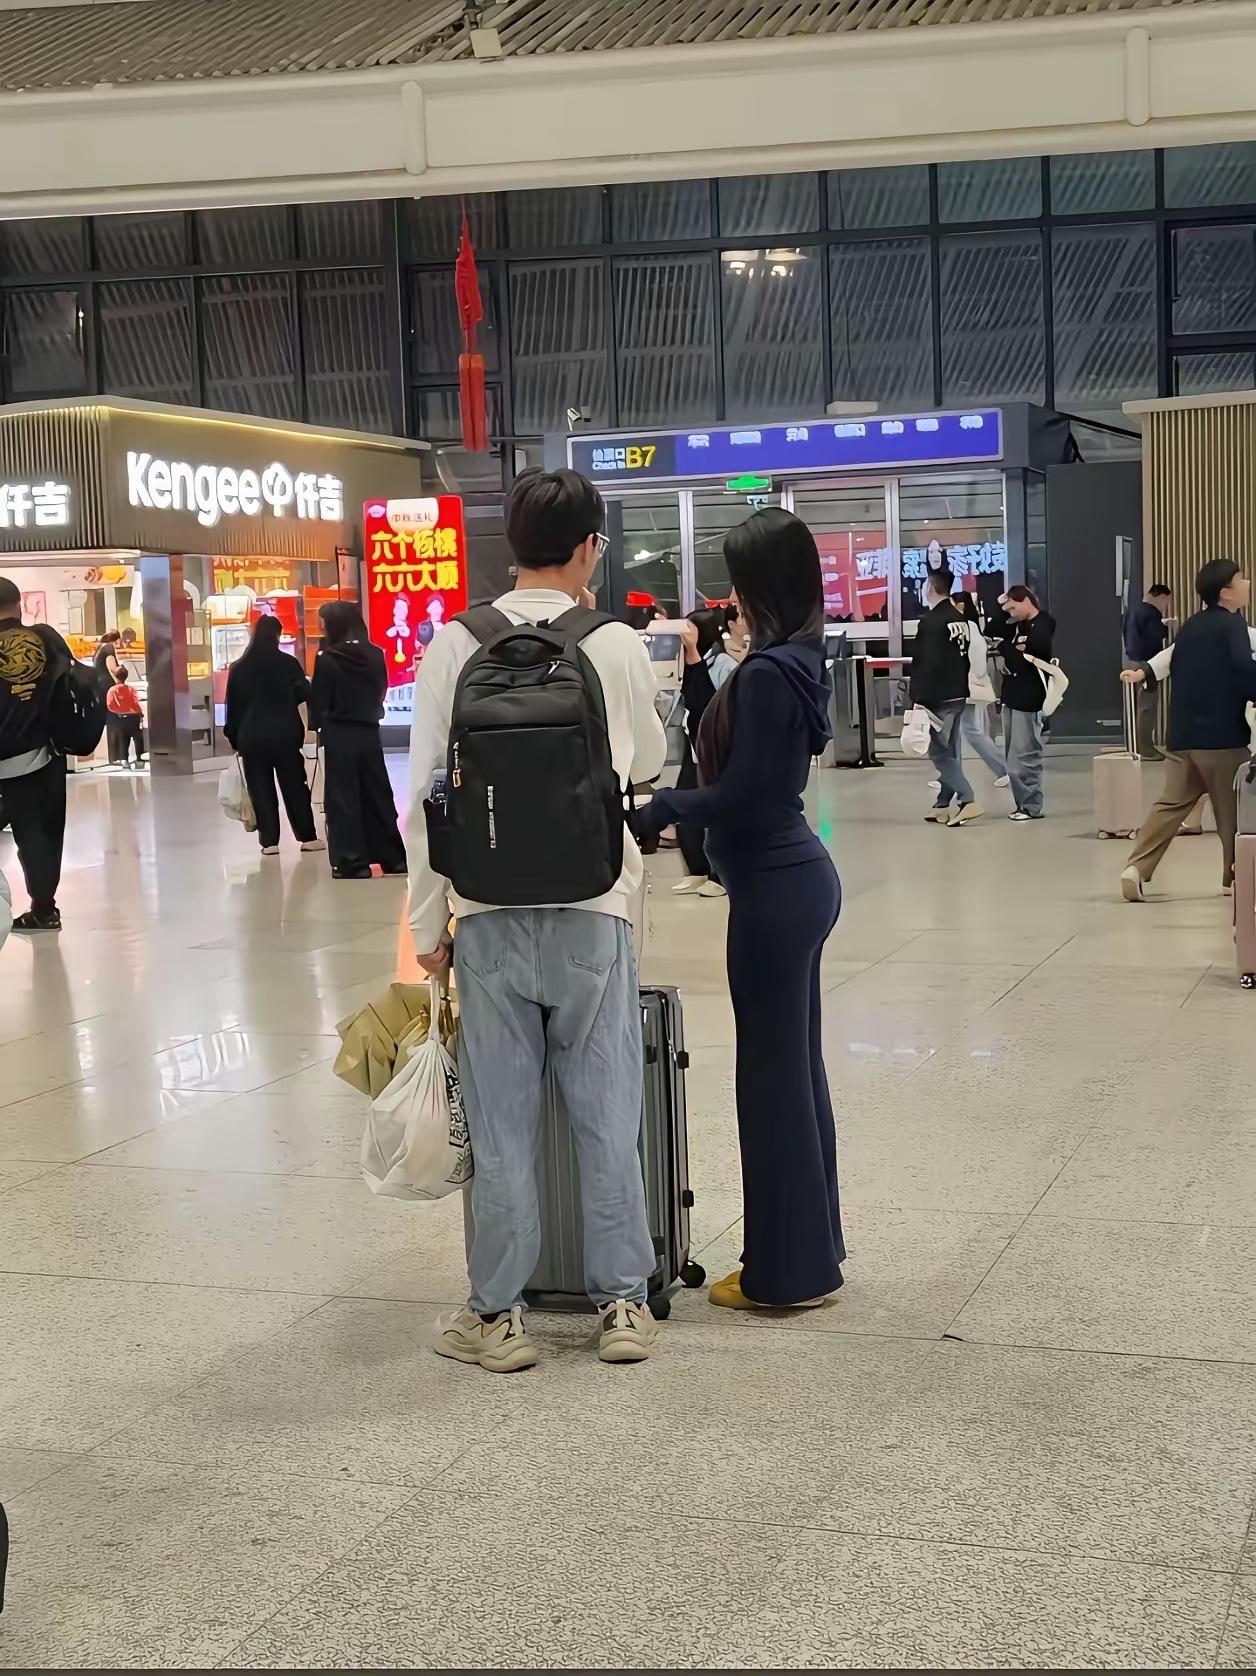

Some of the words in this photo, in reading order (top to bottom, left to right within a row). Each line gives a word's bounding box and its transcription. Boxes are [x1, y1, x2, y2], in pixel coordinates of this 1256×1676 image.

[626, 446, 656, 468] B7
[127, 451, 262, 527] Kengee
[295, 472, 344, 520] 仟吉
